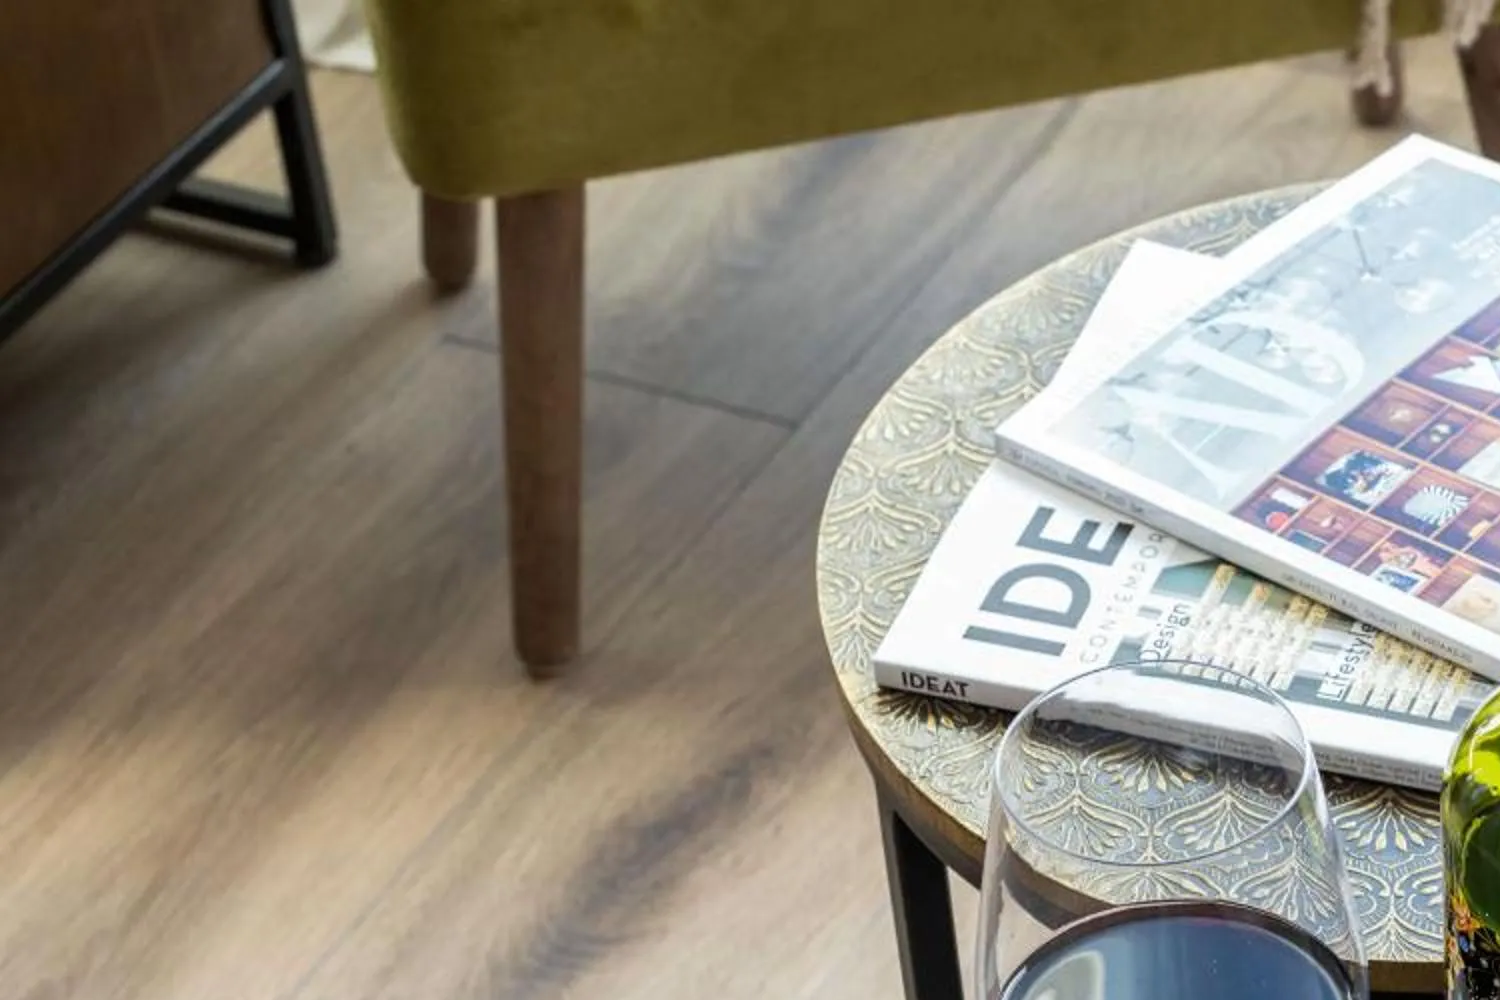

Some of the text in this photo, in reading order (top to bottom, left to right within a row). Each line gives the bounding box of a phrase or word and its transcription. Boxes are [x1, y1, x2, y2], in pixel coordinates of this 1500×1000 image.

[962, 505, 1135, 657] IDE
[1140, 601, 1192, 662] Design
[901, 671, 974, 698] IDEAT
